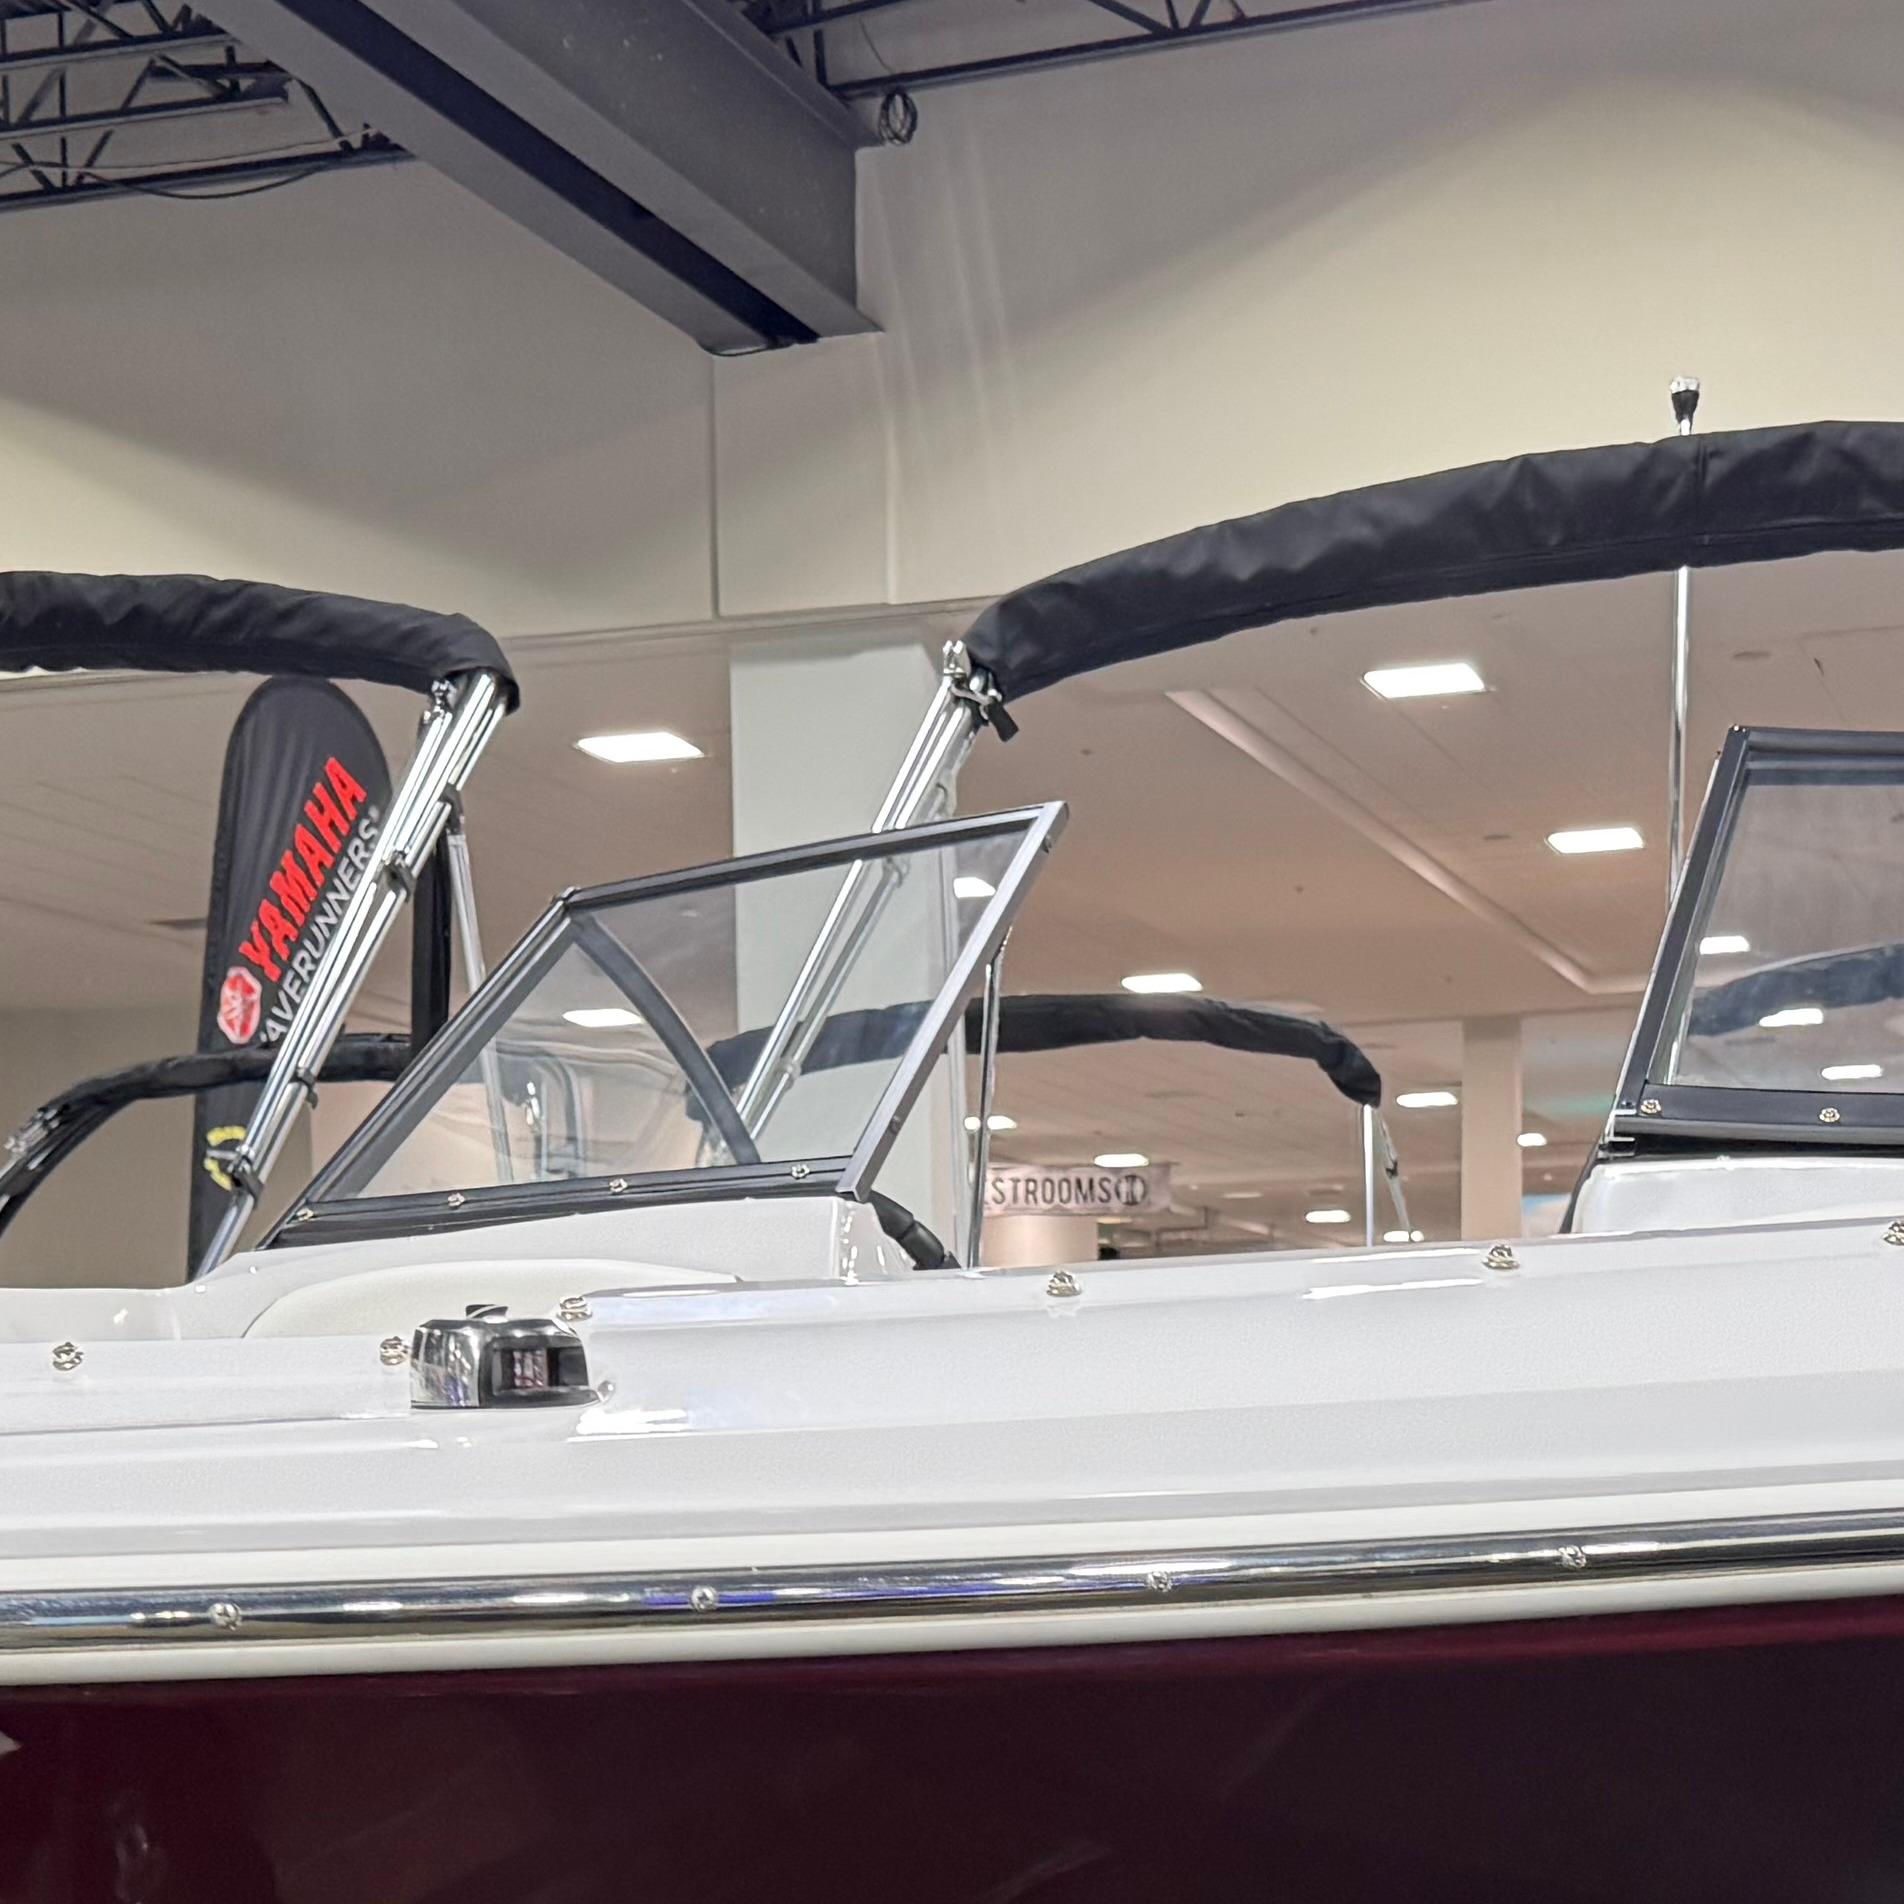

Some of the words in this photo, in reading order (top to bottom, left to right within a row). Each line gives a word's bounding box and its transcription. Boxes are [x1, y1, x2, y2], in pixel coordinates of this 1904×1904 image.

[239, 757, 367, 983] YAMAHA
[259, 812, 380, 1043] AVERUNNERS
[984, 1175, 1113, 1205] STROOMS
